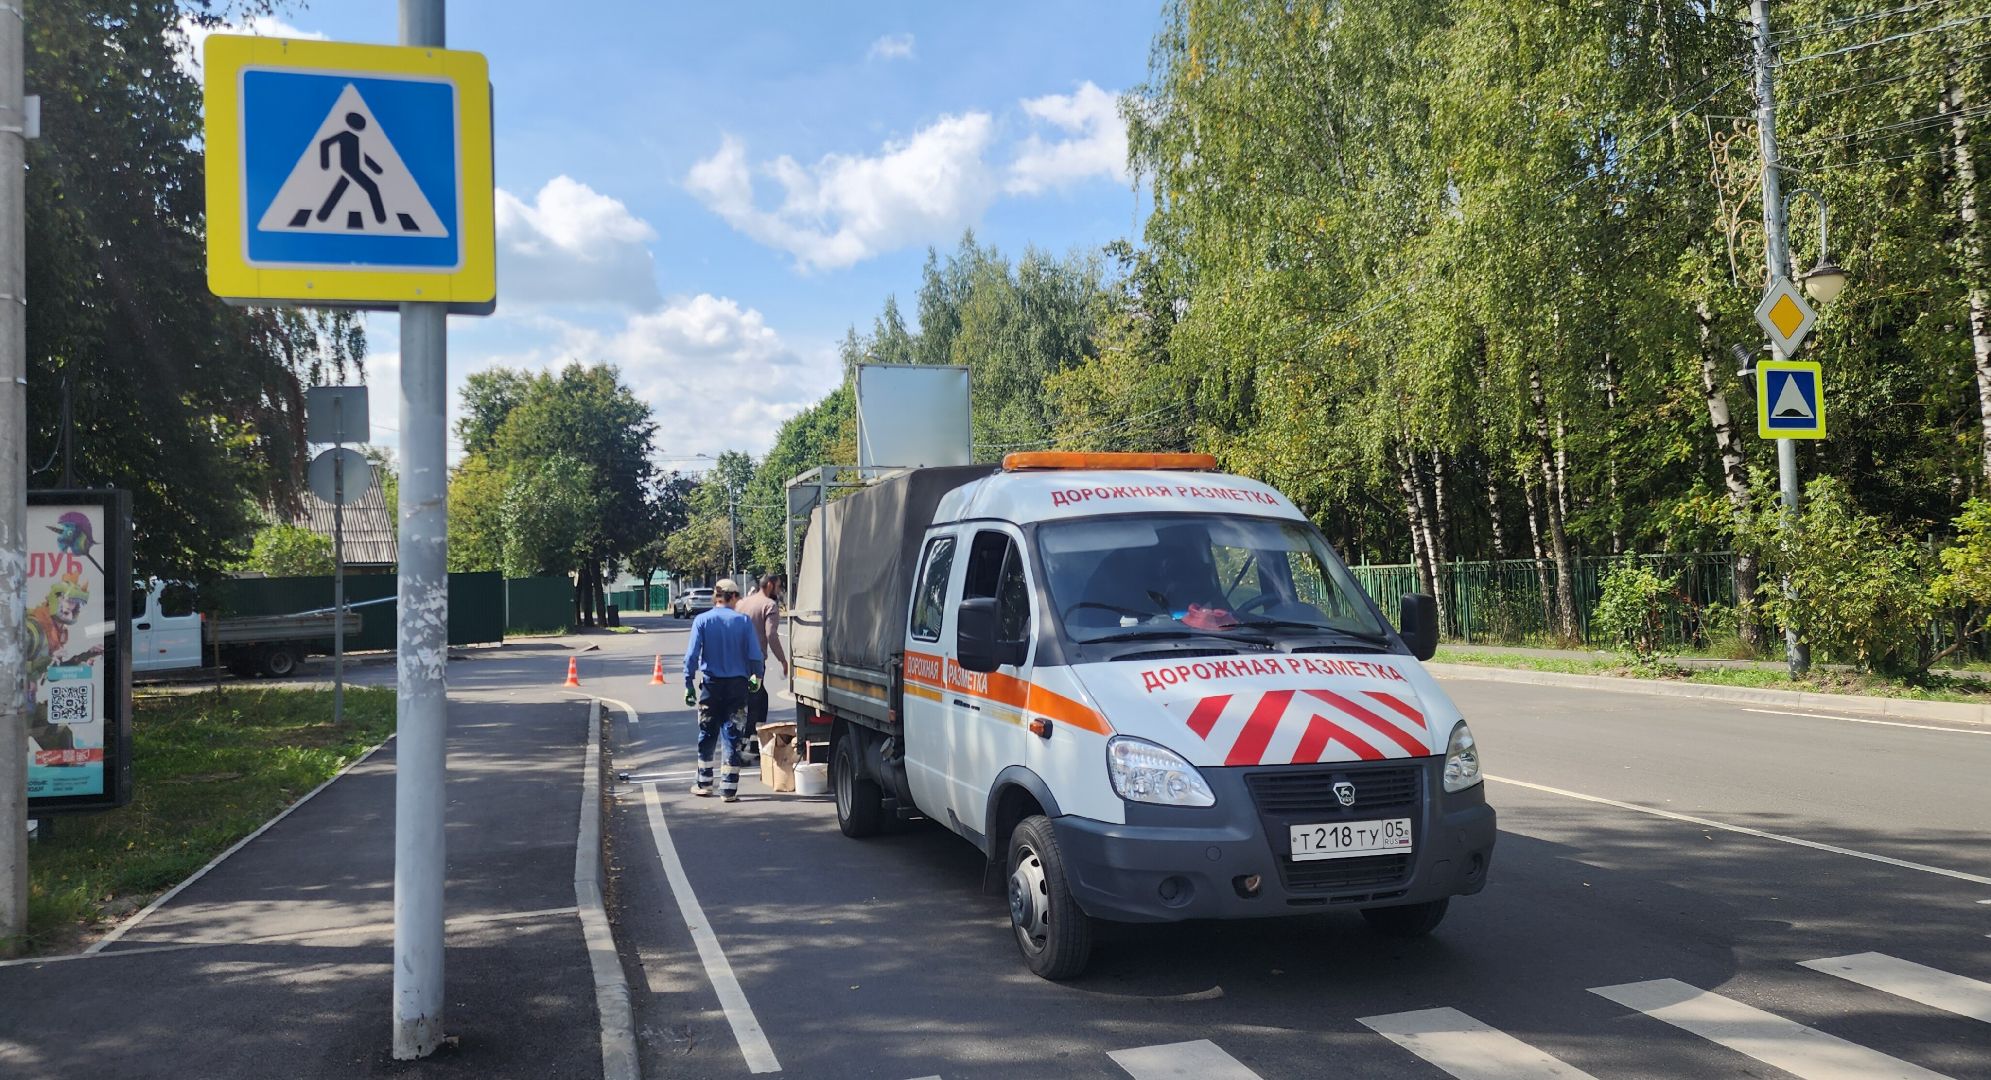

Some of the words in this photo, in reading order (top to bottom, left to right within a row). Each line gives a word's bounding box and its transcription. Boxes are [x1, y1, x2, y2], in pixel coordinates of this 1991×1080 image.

[1051, 485, 1172, 508] ДОРОЖНАЯ
[1175, 486, 1280, 507] РАЗМЕТКА
[27, 552, 83, 577] ЛУБ
[907, 656, 939, 680] ДОРОЖНАЯ
[948, 665, 988, 694] РАЗМЕТКА
[1141, 658, 1285, 693] ДОРОЖНАЯ
[1286, 658, 1408, 683] РАЗМЕТКА
